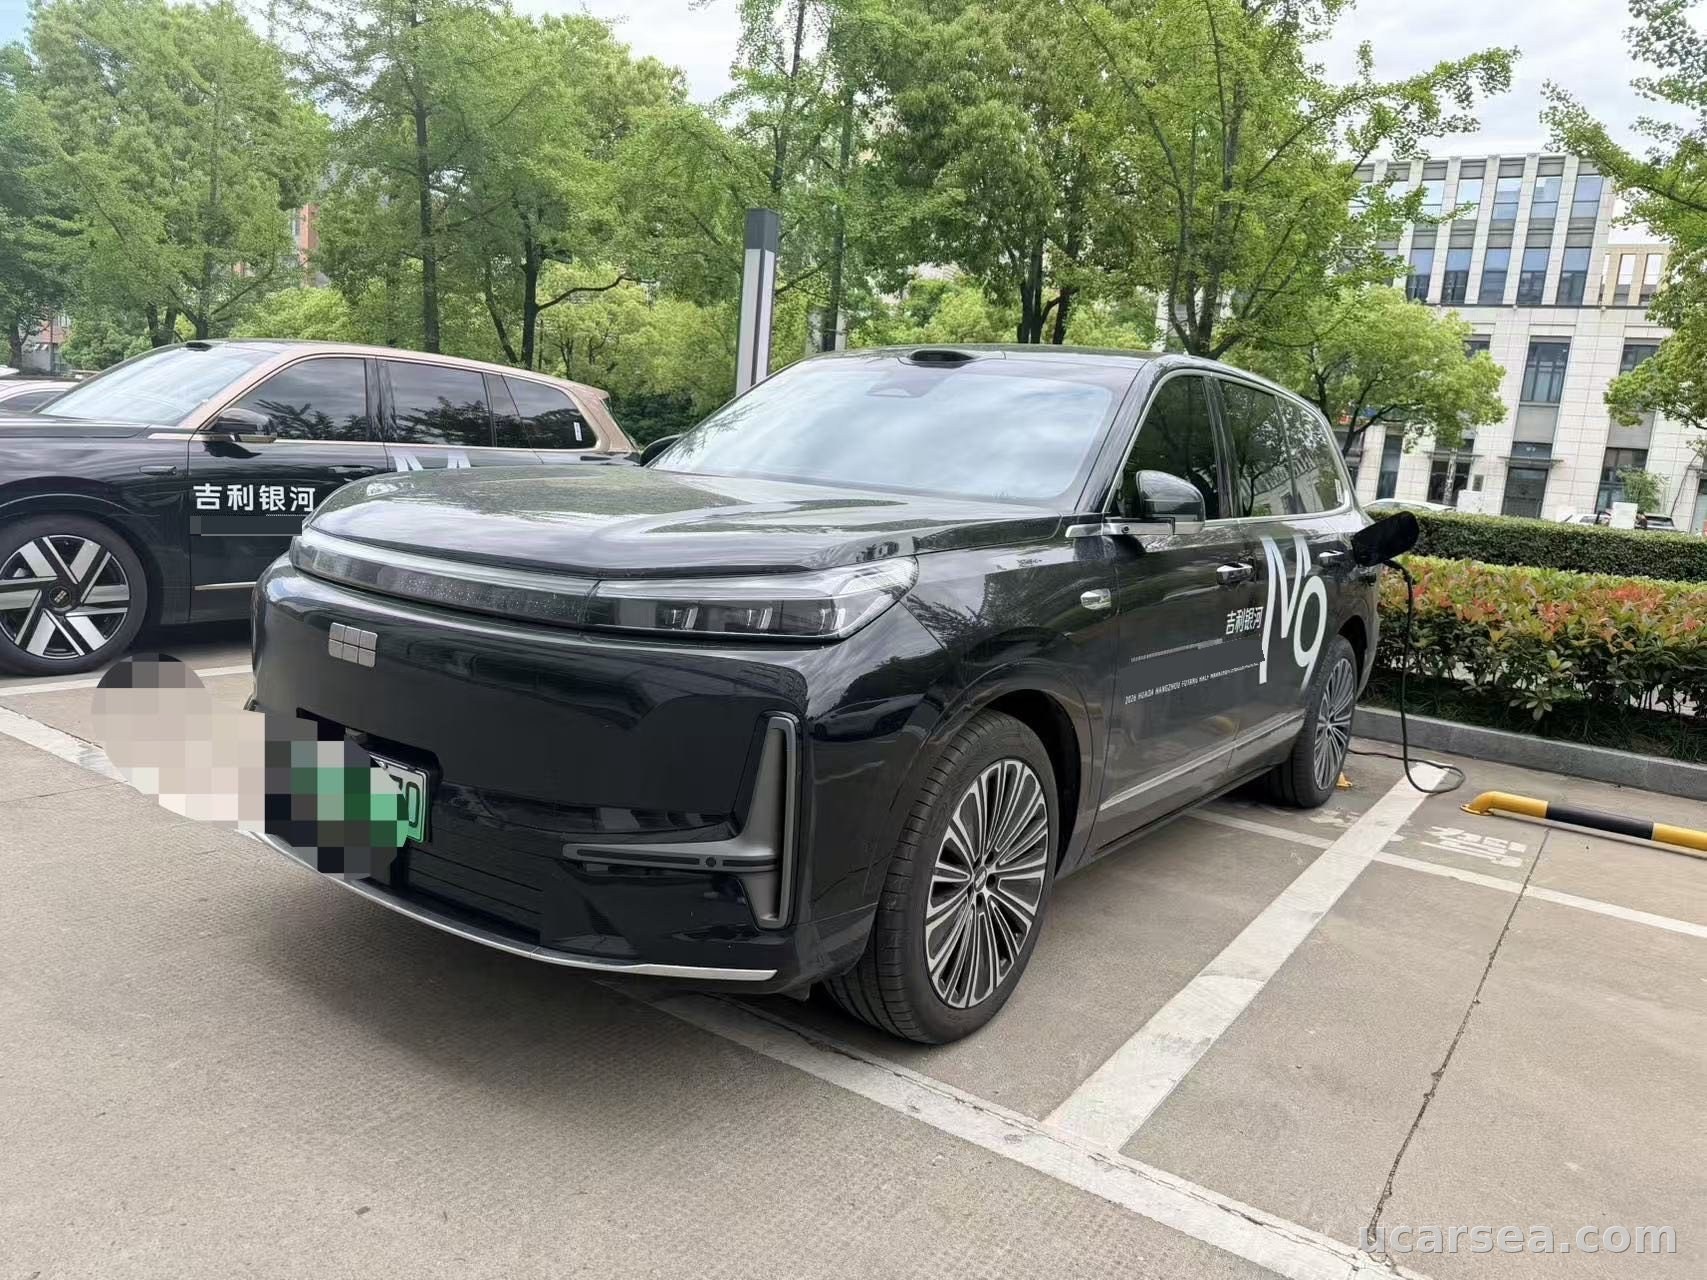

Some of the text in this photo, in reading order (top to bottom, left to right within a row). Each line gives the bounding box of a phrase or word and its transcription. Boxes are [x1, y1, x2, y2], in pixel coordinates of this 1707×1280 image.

[192, 482, 315, 512] 吉利银河
[1225, 605, 1265, 636] 吉利银河
